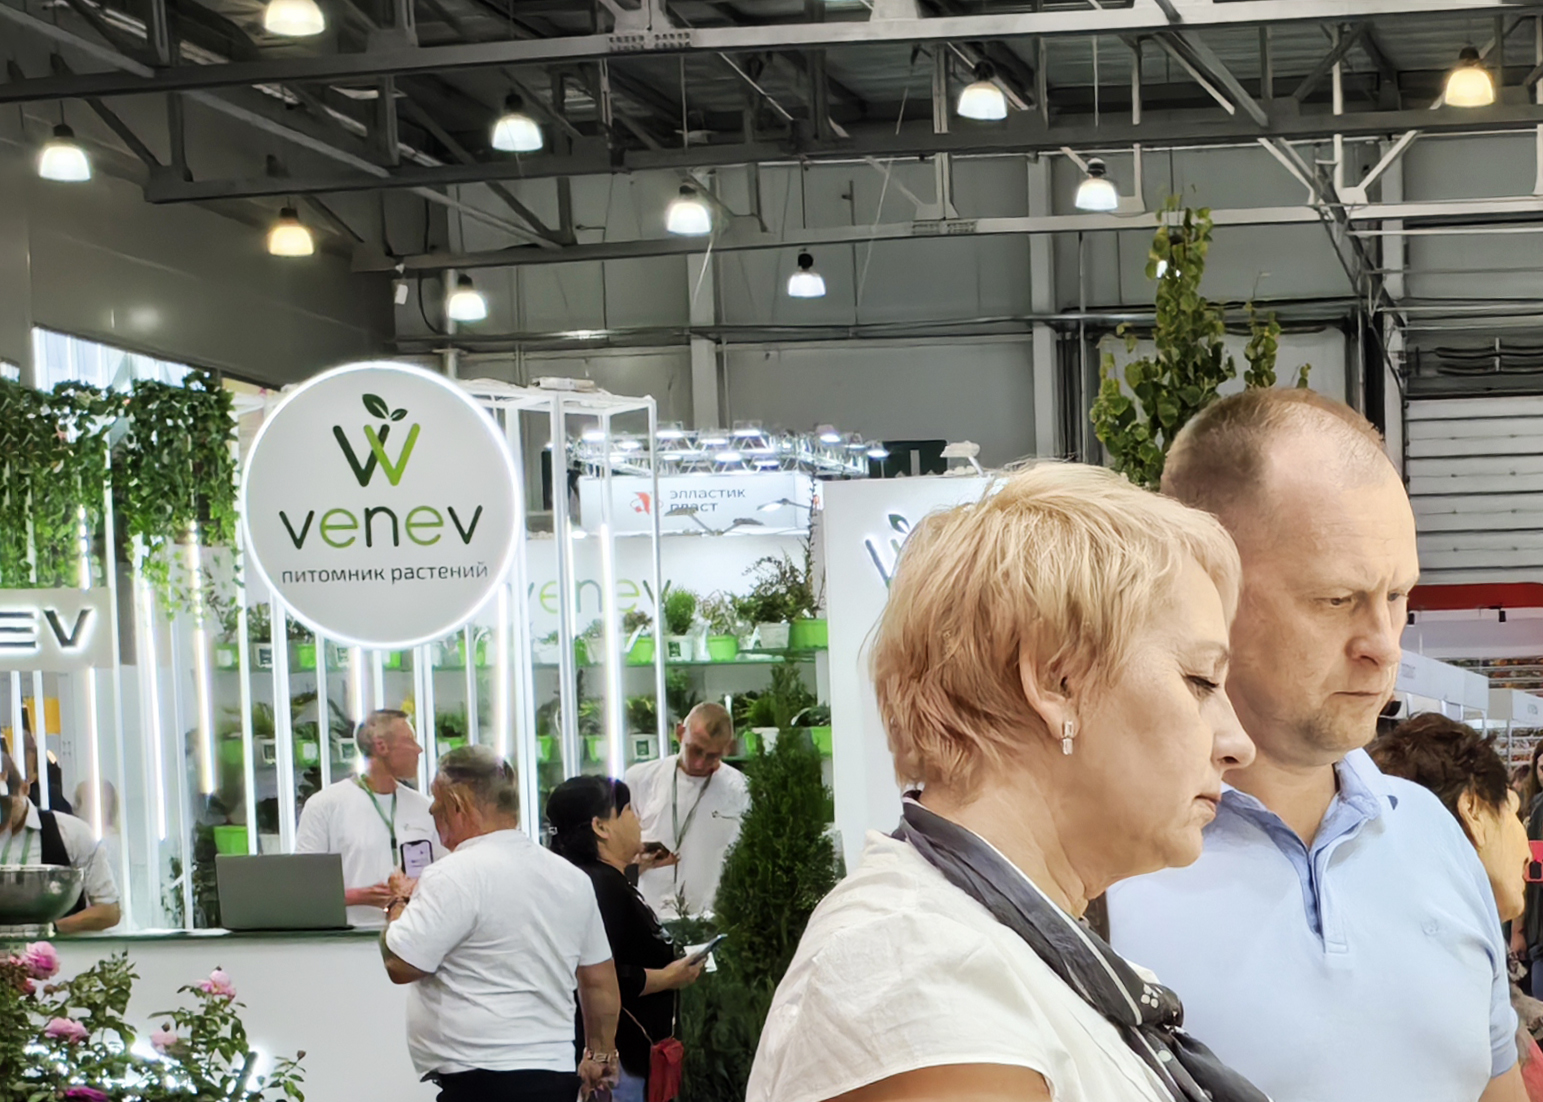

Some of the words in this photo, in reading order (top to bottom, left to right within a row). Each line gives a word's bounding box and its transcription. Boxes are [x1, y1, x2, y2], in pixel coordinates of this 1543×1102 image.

[279, 505, 483, 549] venev
[282, 568, 385, 584] питомник
[391, 561, 488, 585] растений
